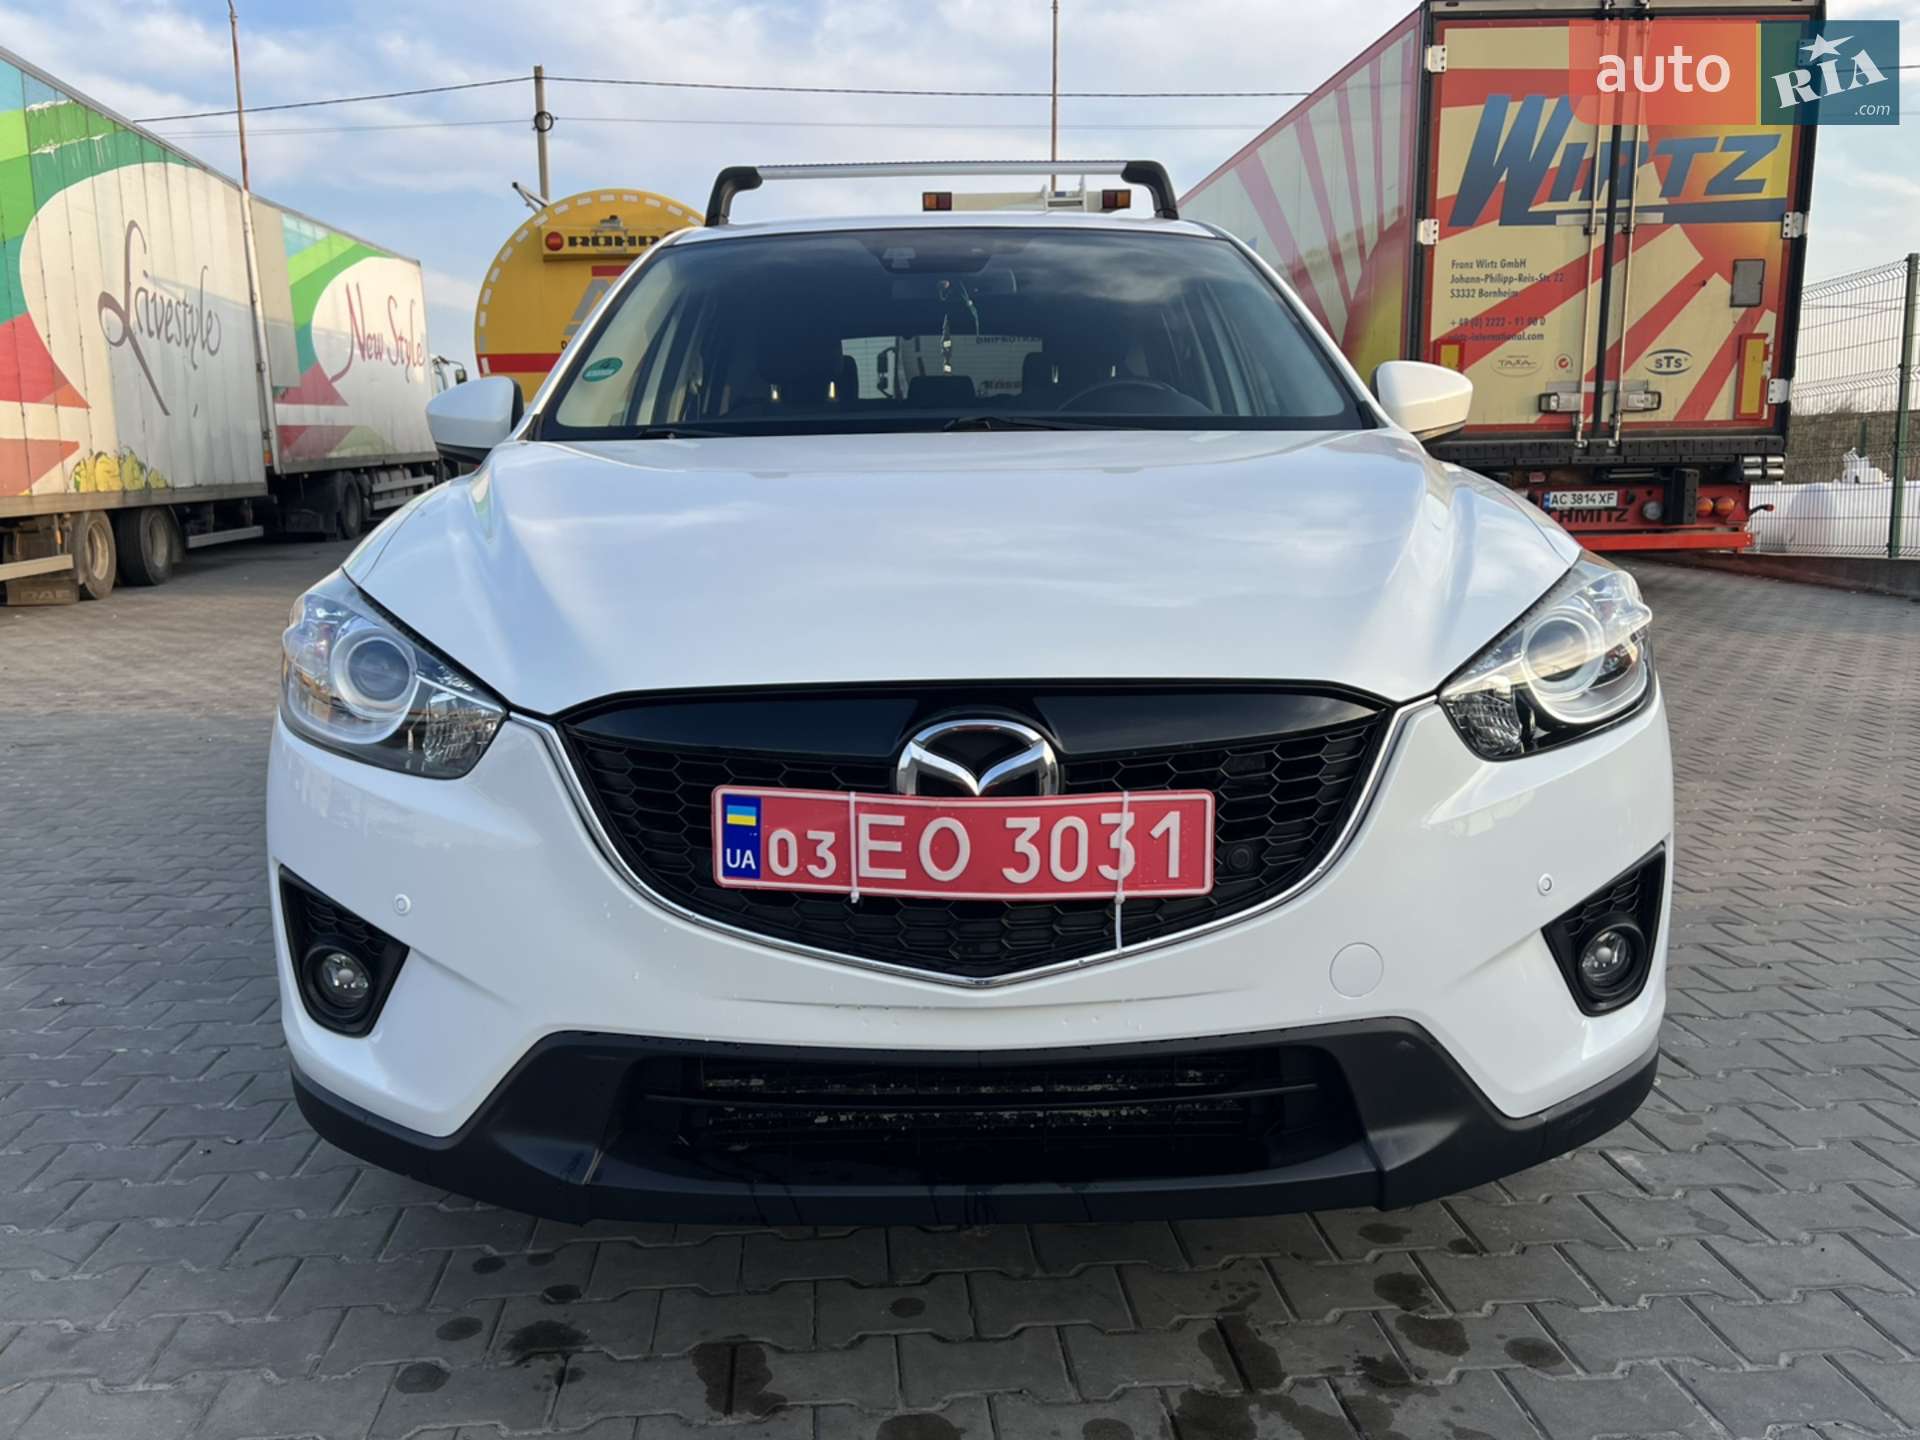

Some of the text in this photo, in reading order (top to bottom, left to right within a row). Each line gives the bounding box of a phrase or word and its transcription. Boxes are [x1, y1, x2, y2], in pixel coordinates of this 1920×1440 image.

[1451, 258, 1527, 269] Franz Wirtz GmbH
[1554, 273, 1565, 283] 22
[1450, 287, 1519, 299] 53332 Bornheim
[329, 281, 426, 386] New Style
[1551, 493, 1568, 505] AC
[1570, 493, 1596, 505] 3814
[767, 810, 1181, 883] 03 EO 3031
[726, 848, 757, 870] UA
